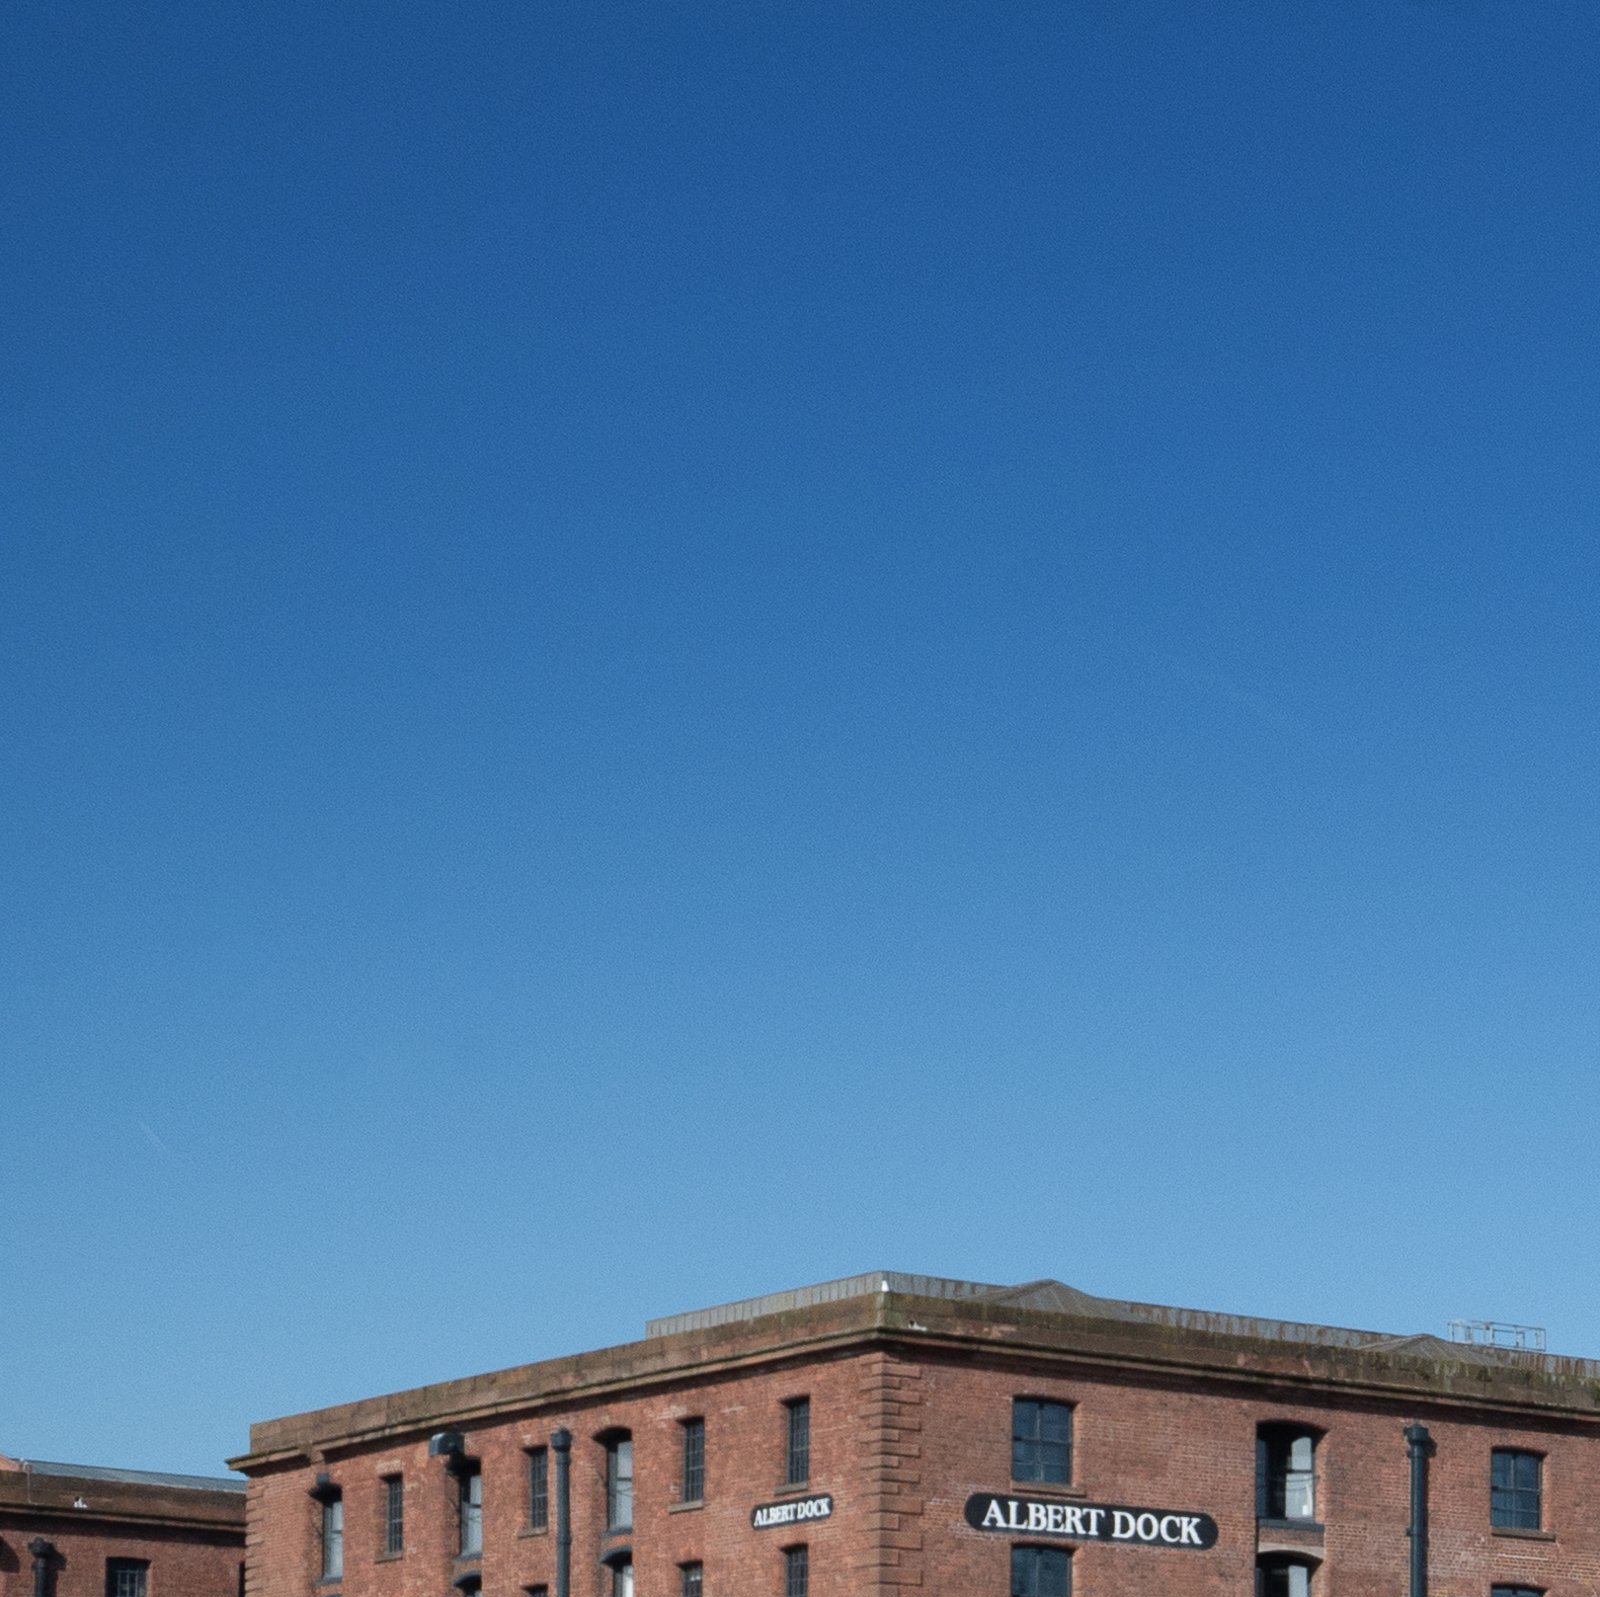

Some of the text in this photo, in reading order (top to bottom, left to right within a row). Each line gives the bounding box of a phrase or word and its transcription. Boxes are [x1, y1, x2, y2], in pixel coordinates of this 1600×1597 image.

[753, 1497, 831, 1527] ALBERT DOCK
[982, 1499, 1203, 1545] ALBERT DOCK
